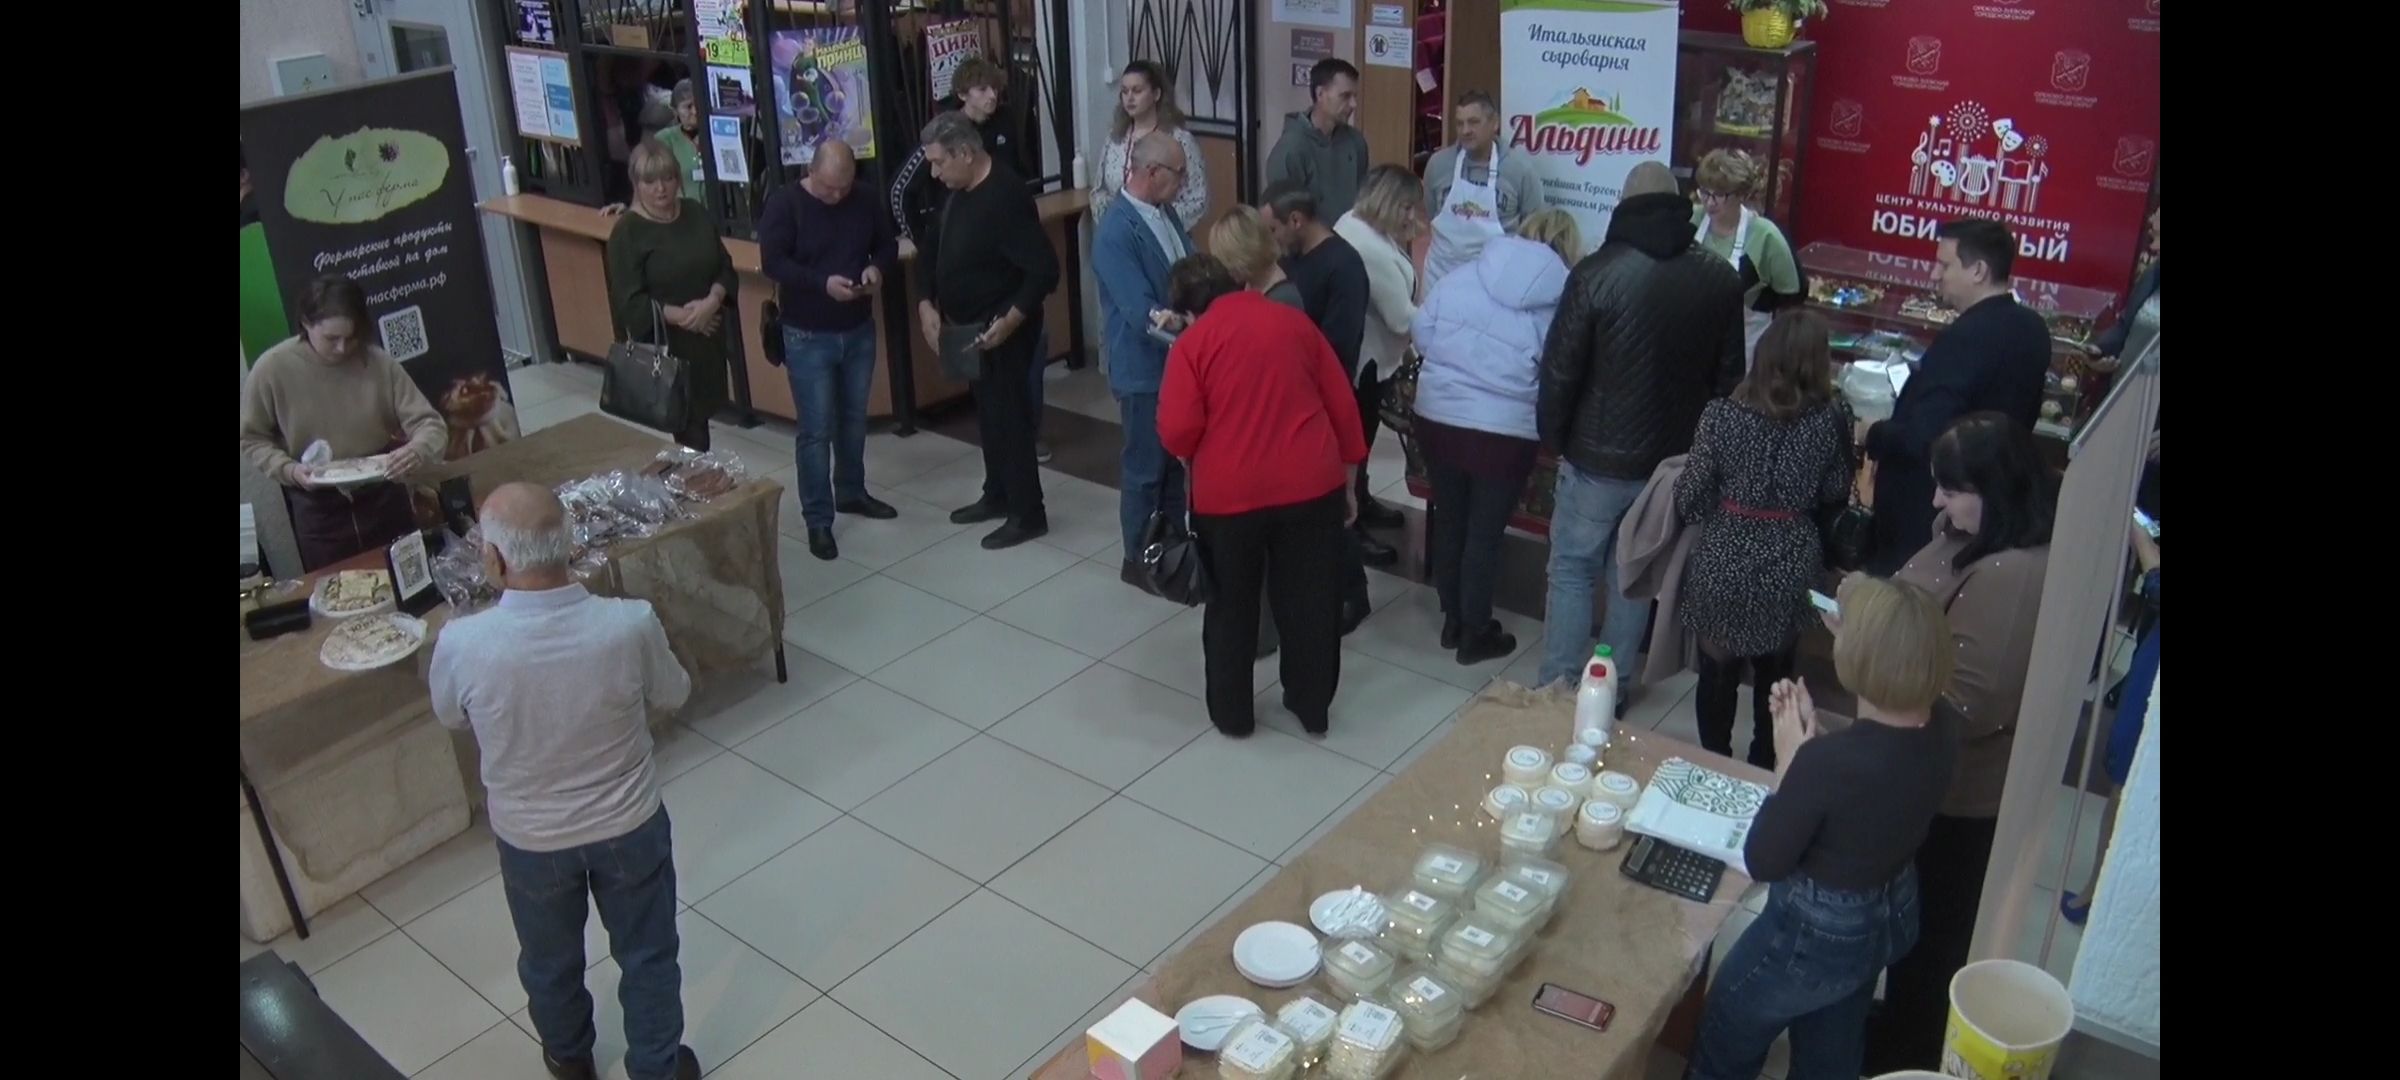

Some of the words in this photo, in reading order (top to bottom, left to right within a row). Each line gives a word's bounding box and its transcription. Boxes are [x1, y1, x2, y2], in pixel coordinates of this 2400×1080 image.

[706, 42, 719, 57] 19
[932, 33, 979, 57] ЦИРК
[1528, 23, 1647, 51] Итальянская
[1541, 50, 1630, 72] сыроварня
[1509, 114, 1661, 167] Альдини
[1876, 193, 1913, 208] ЦЕНТР
[1917, 200, 2001, 222] КУЛЬТУРНОГО
[2005, 213, 2071, 232] РАЗВИТИЯ
[313, 238, 391, 272] Фермерские
[393, 221, 453, 247] продукты
[1872, 210, 2068, 262] ЮБИЫЙ
[404, 251, 420, 264] на
[424, 245, 448, 263] дом
